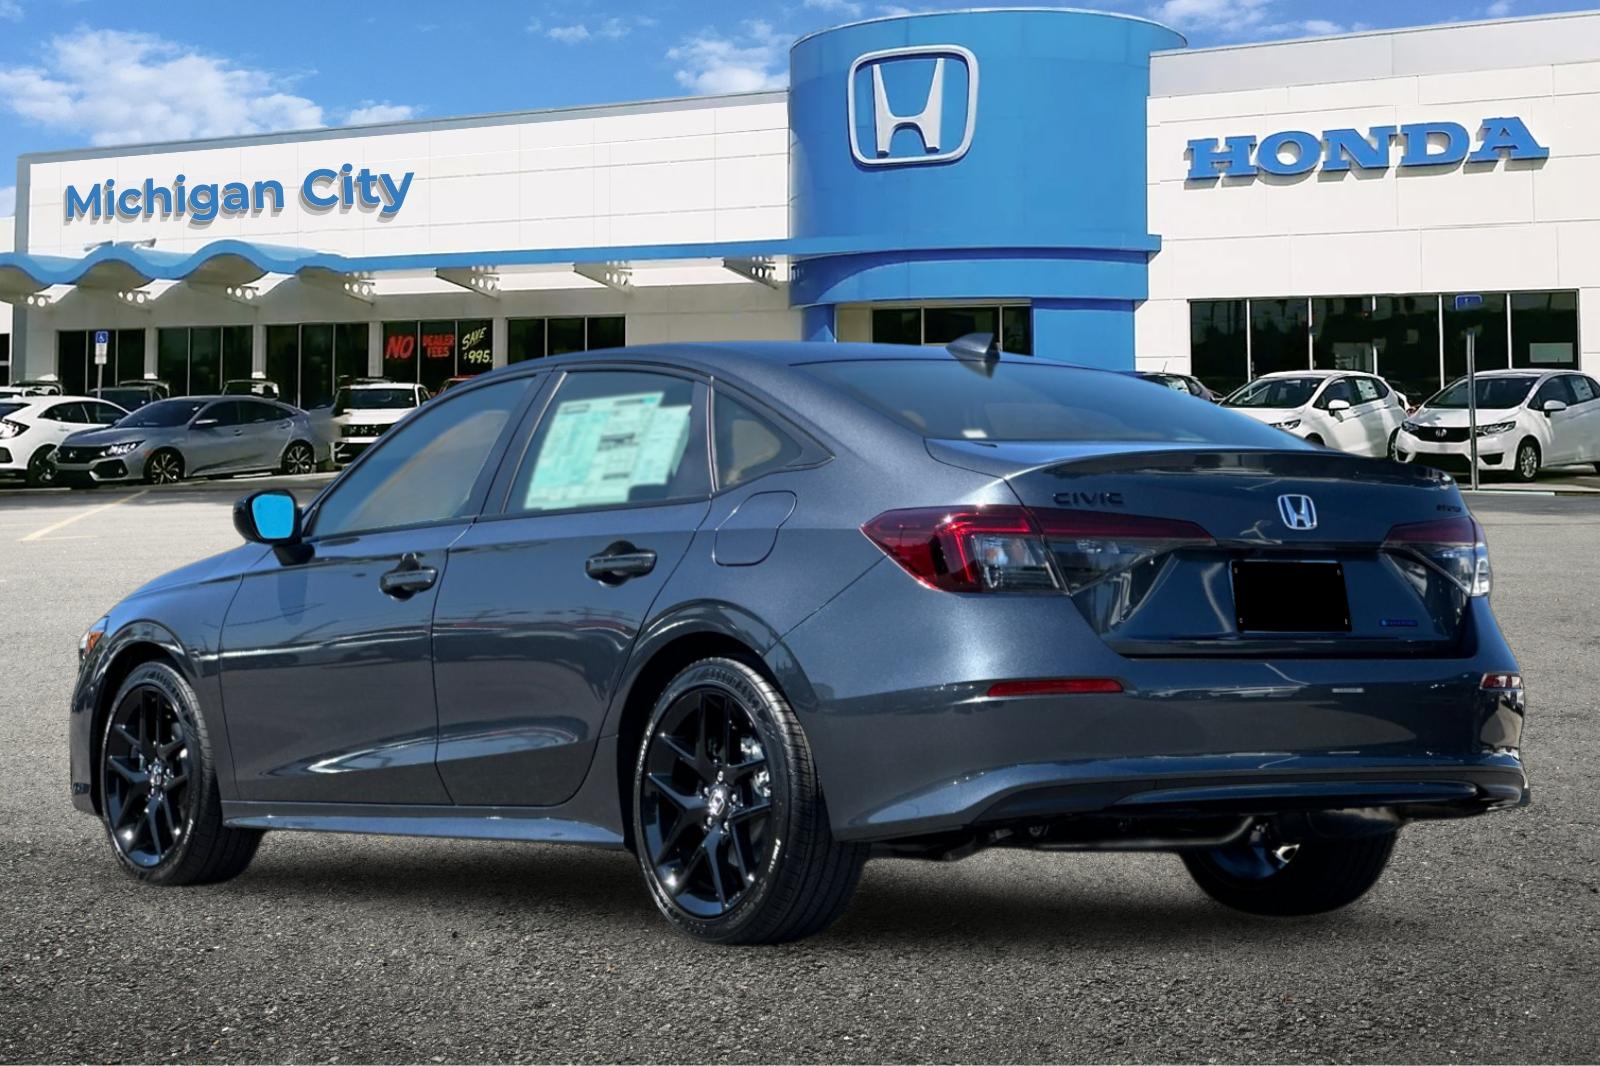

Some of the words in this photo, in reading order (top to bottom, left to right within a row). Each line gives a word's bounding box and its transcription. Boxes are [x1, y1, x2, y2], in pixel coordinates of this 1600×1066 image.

[1185, 116, 1550, 181] HONDA
[66, 174, 284, 222] Michigan
[301, 163, 415, 215] City
[386, 335, 415, 359] NO
[461, 327, 487, 350] SAVE
[1052, 492, 1124, 505] CIVIC
